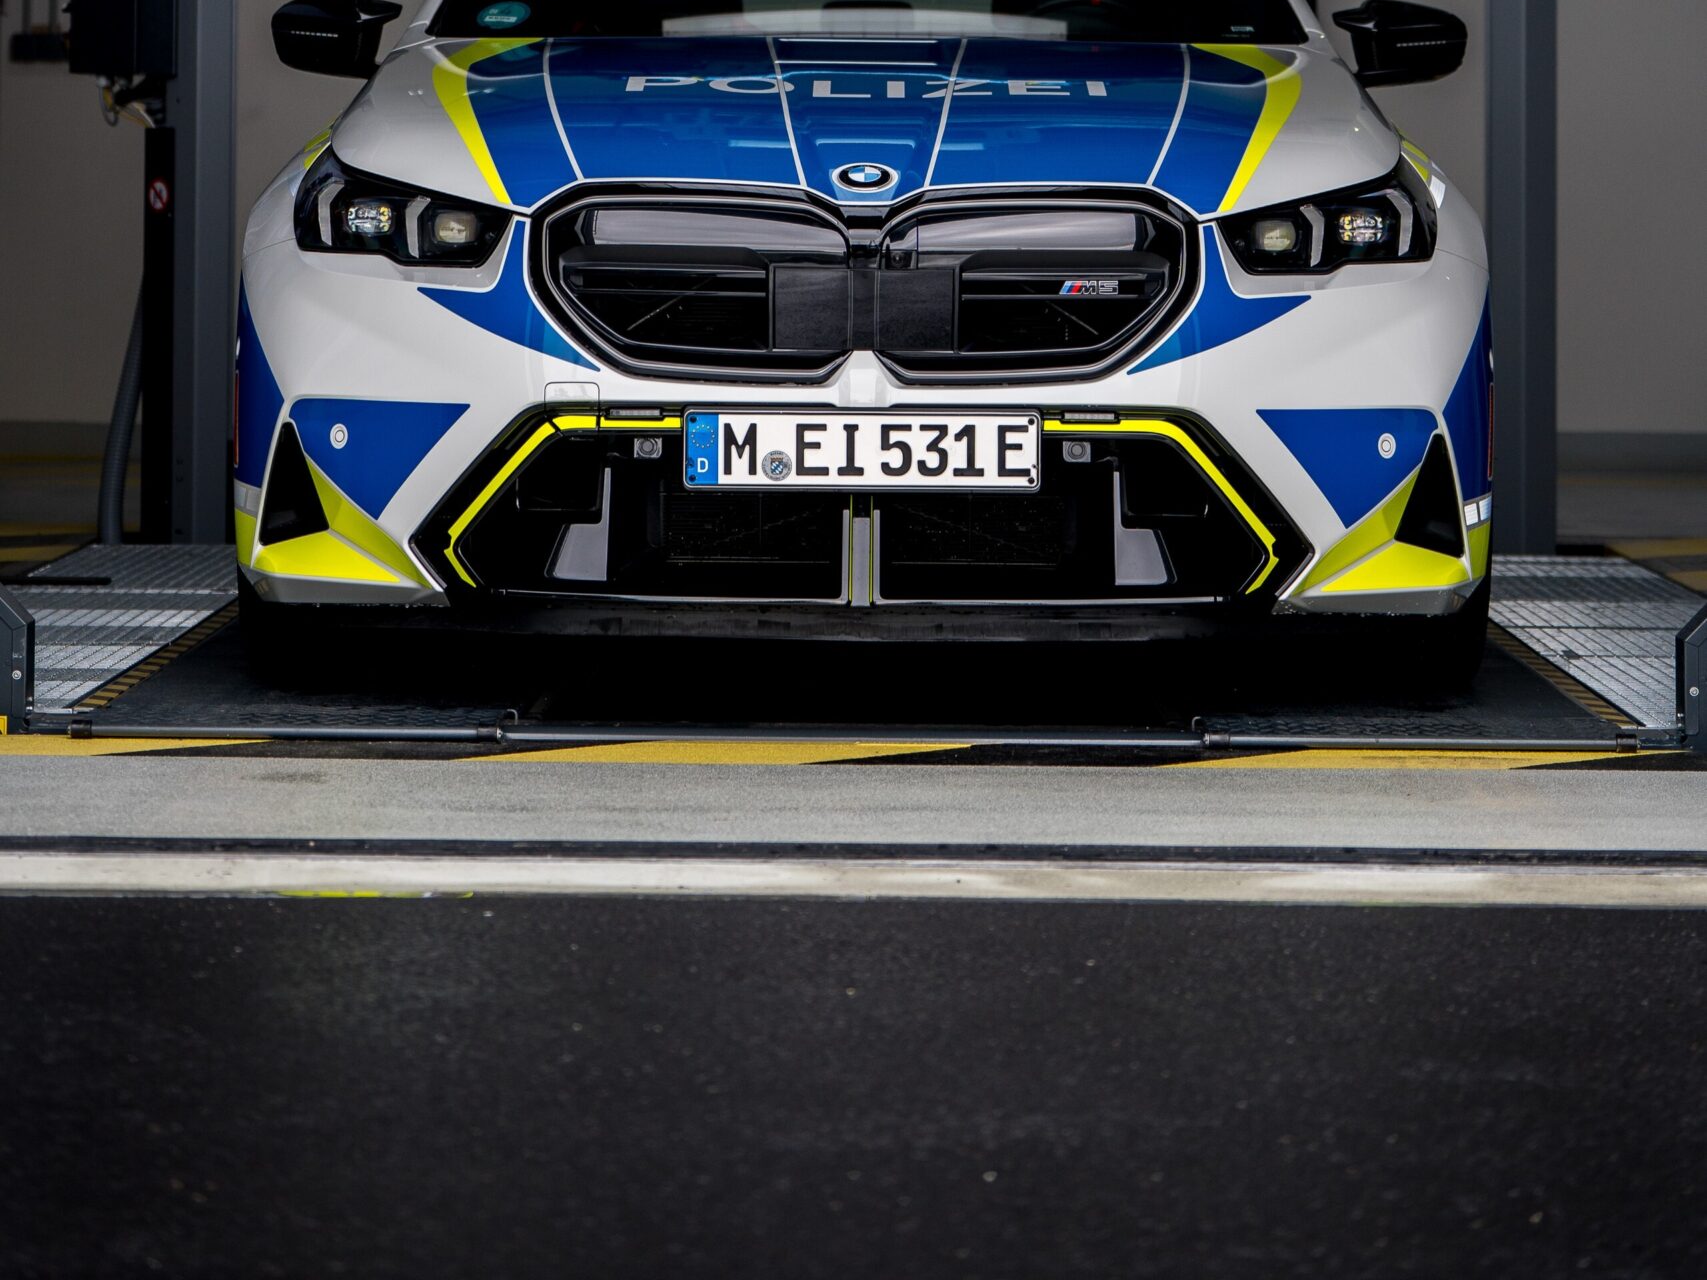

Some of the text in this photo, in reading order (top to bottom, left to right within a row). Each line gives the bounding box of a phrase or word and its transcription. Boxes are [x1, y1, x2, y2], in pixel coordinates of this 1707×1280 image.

[625, 76, 1107, 98] POLIZEI
[1068, 280, 1118, 295] M5
[723, 423, 757, 476] M
[697, 458, 709, 473] D
